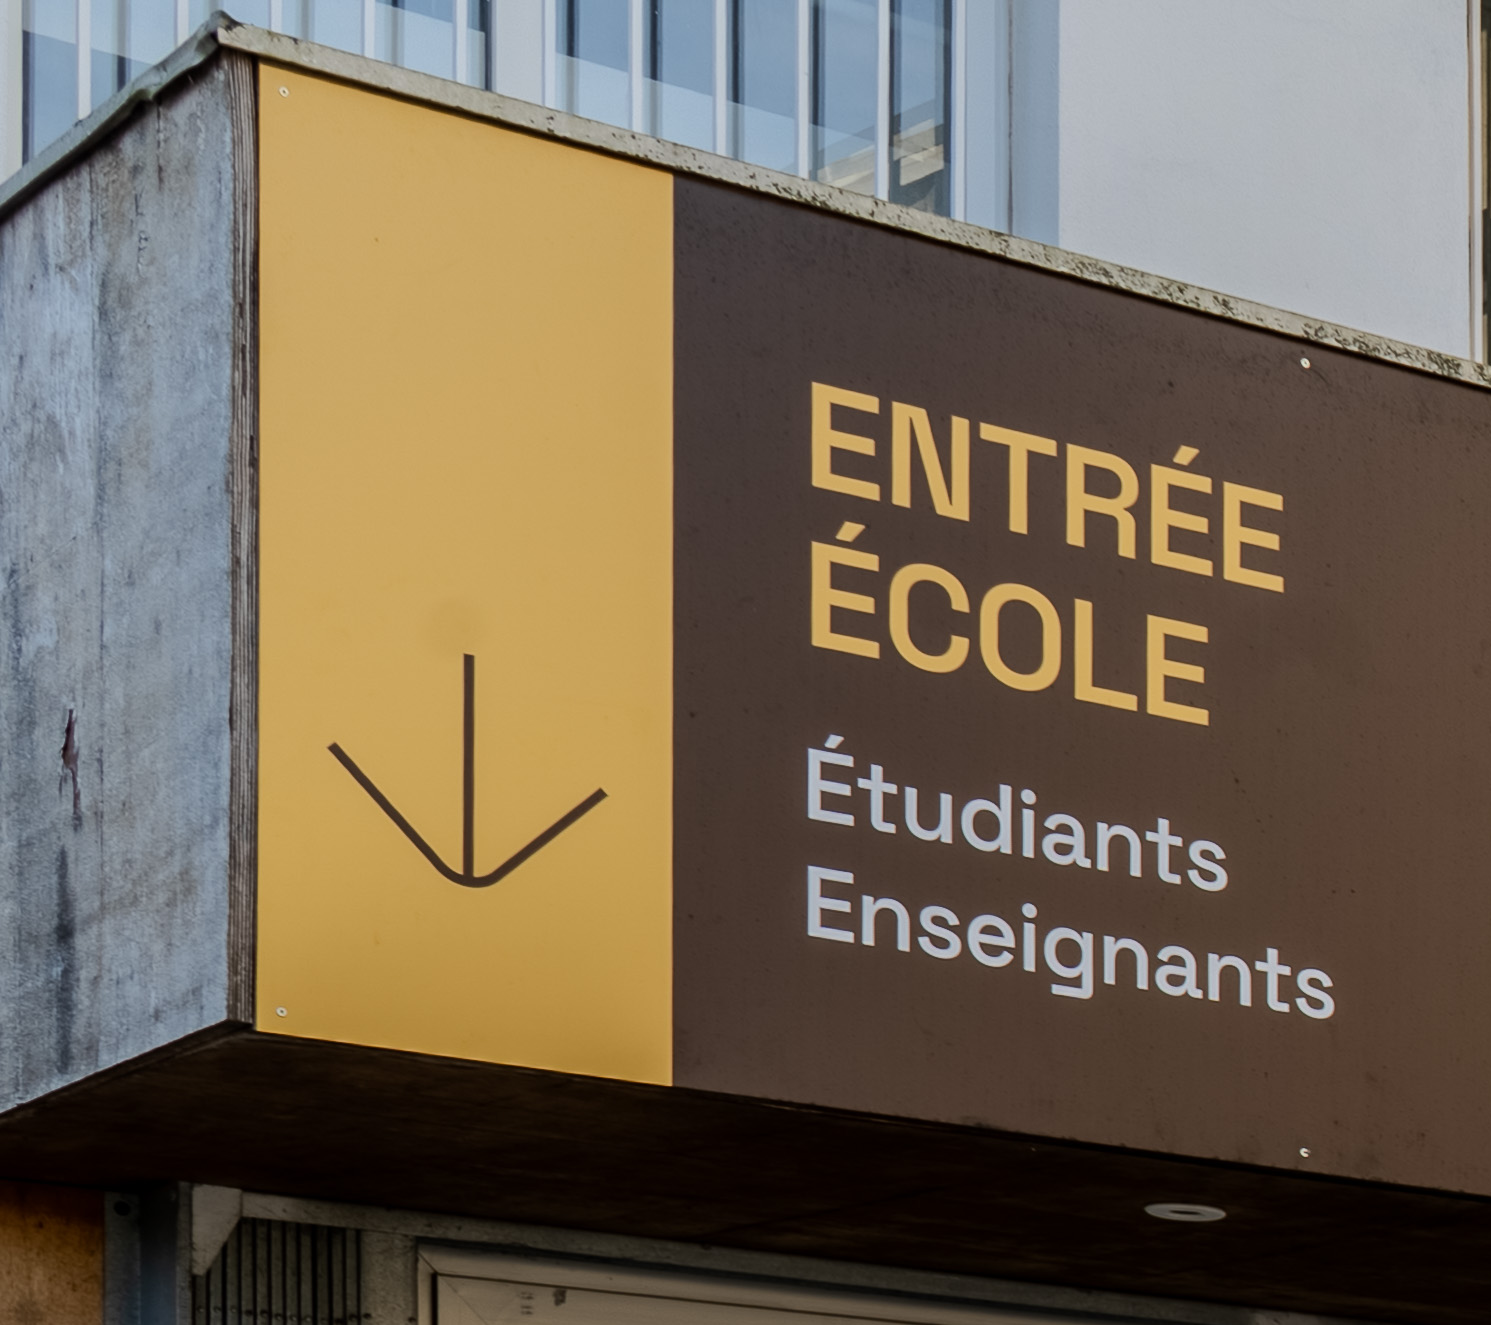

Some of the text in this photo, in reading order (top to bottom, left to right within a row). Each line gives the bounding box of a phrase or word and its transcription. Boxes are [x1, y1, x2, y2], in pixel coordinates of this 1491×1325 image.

[811, 381, 1285, 593] ENTRÉE
[811, 521, 1210, 727] ÉCOLE
[806, 734, 1228, 891] Étudiants
[806, 864, 1336, 1019] Enseignants
